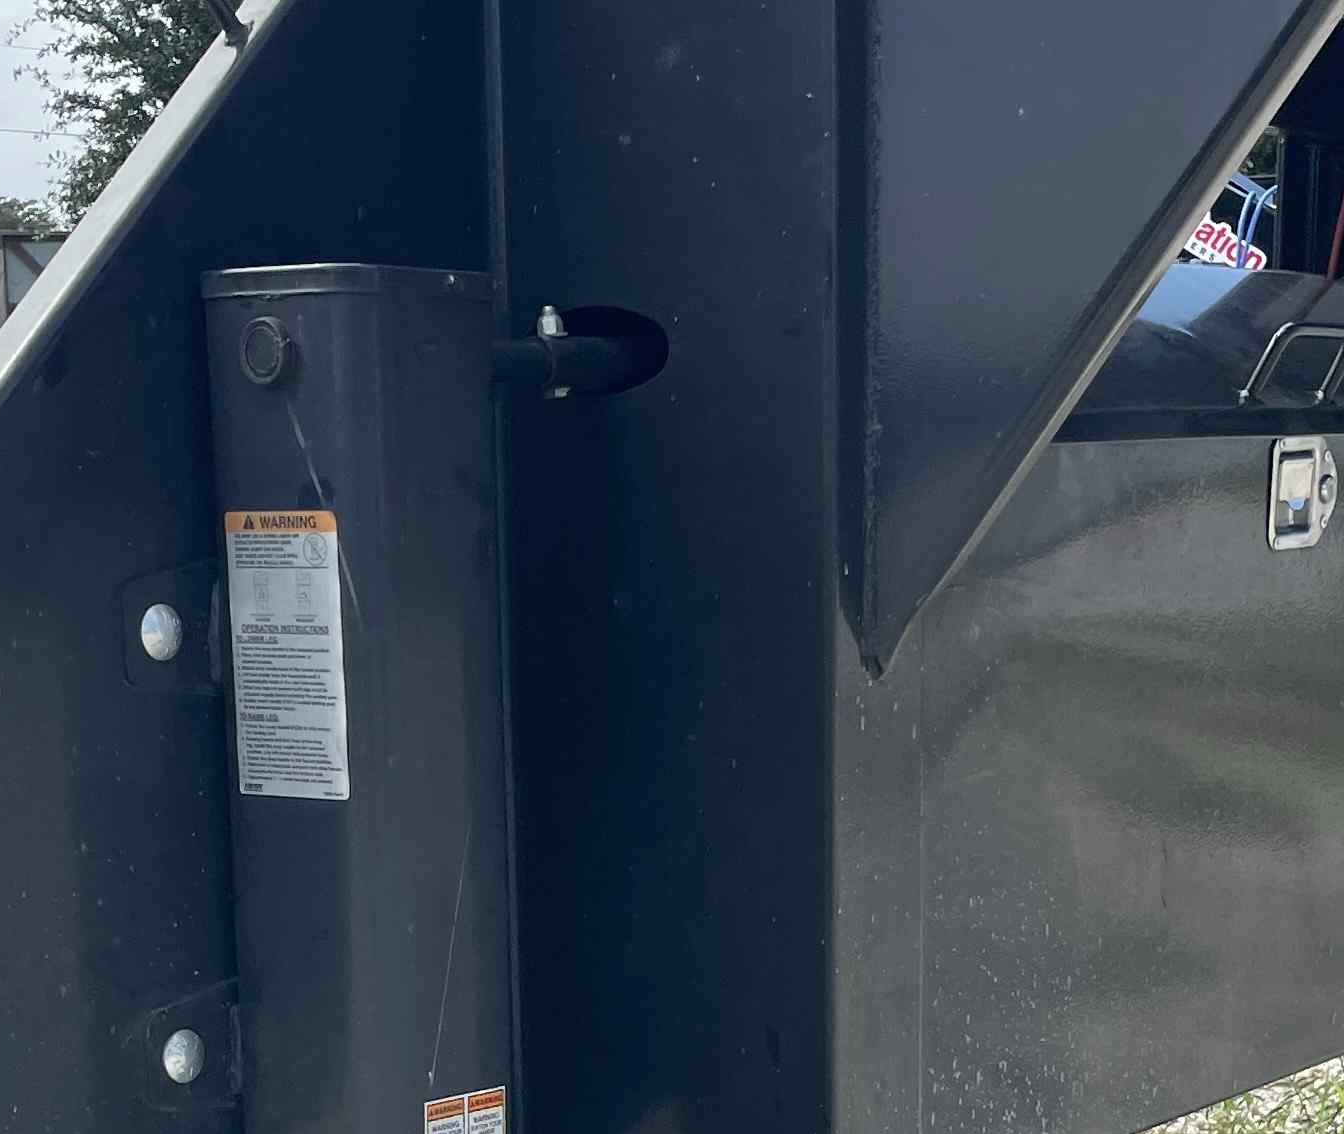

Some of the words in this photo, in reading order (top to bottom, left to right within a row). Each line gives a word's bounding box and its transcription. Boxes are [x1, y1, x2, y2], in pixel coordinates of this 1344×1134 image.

[259, 515, 317, 529] WARNING
[241, 623, 280, 633] OPERATION
[281, 624, 329, 635] INSTRUCTIONS
